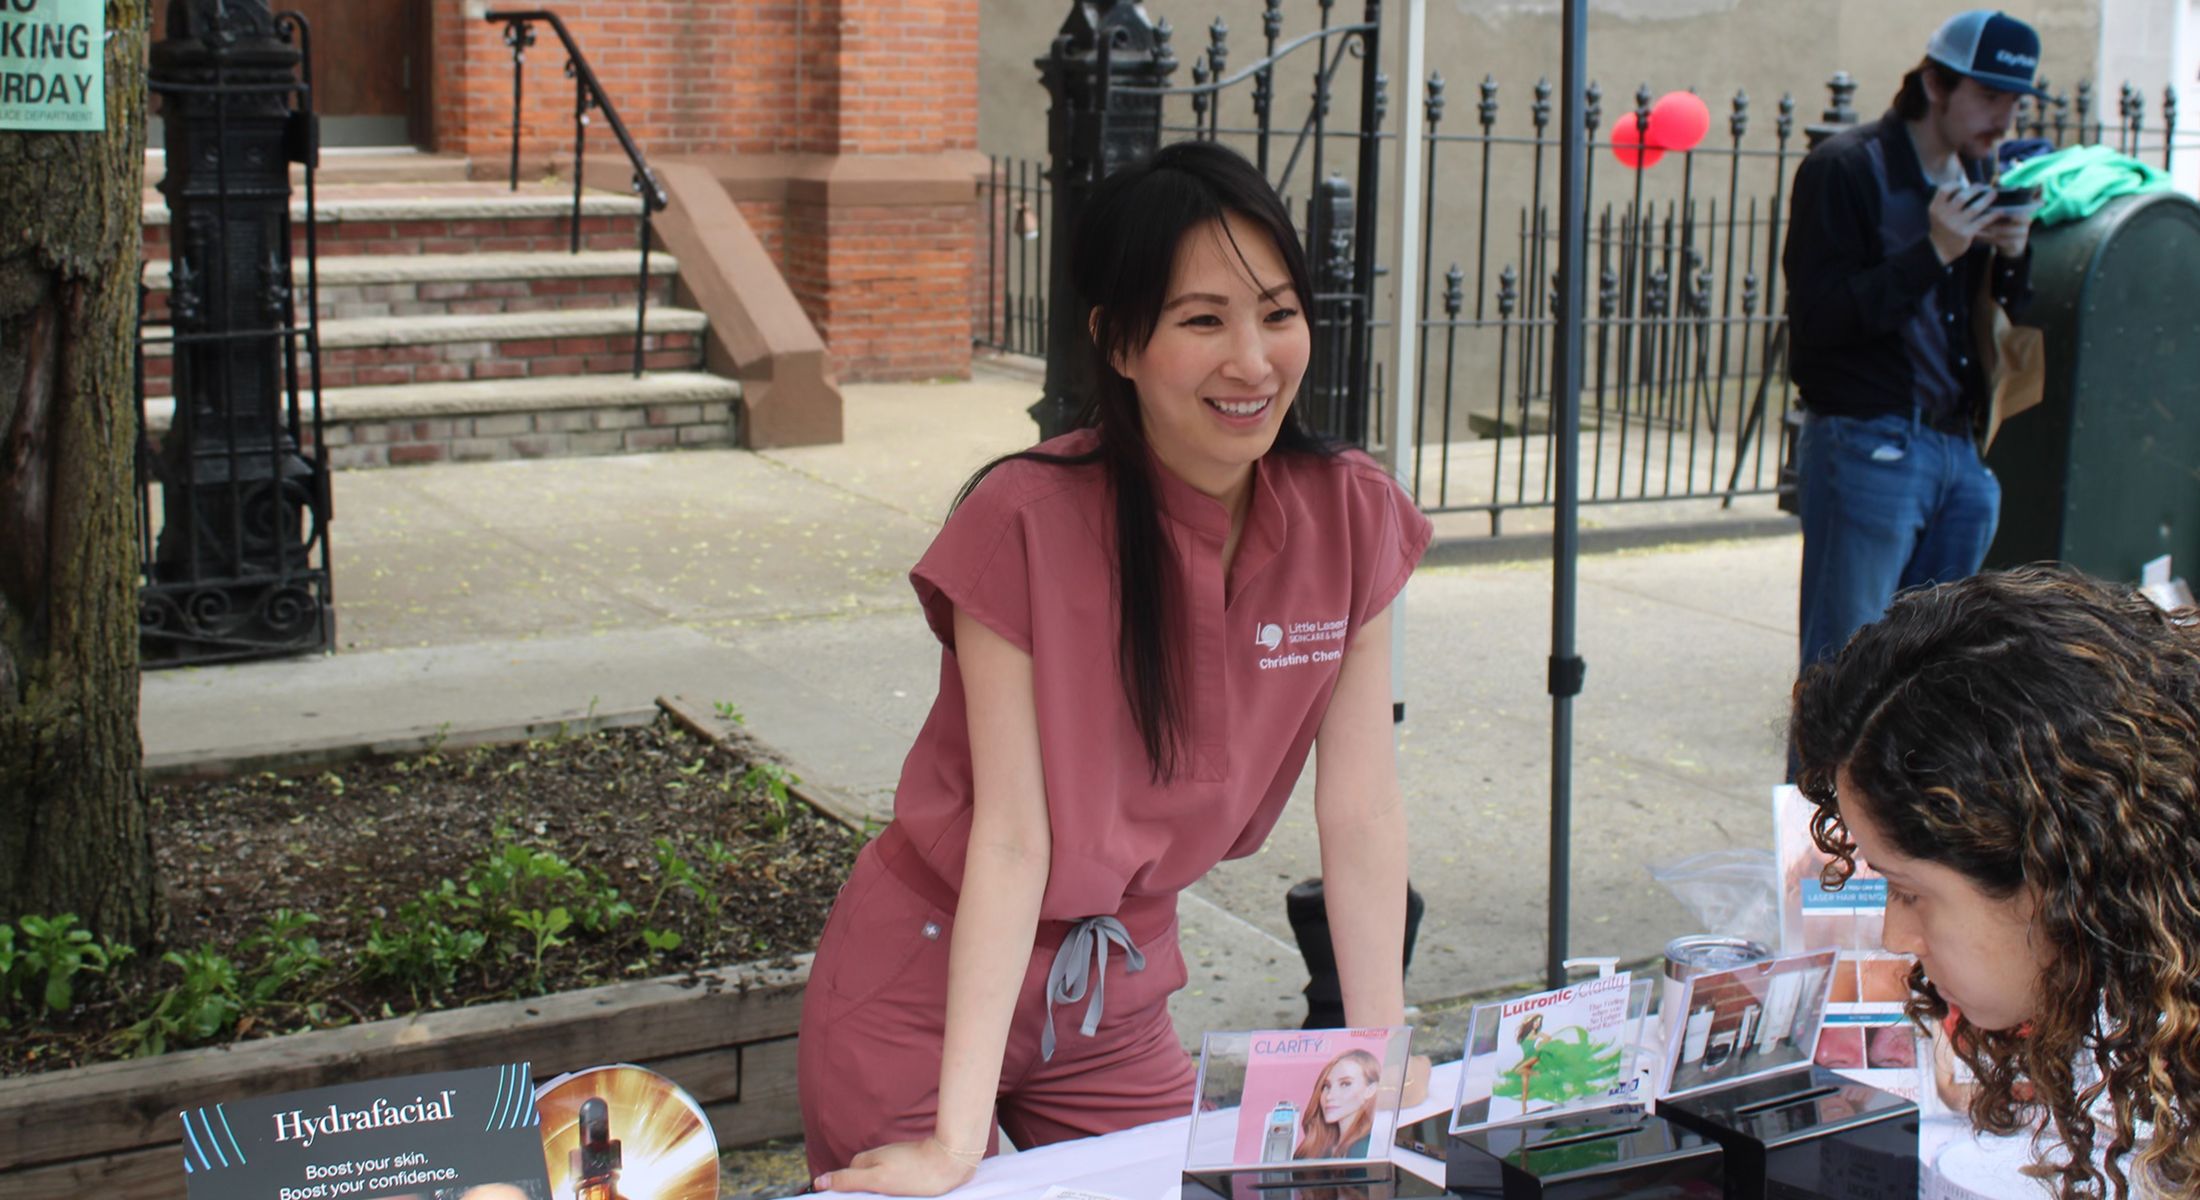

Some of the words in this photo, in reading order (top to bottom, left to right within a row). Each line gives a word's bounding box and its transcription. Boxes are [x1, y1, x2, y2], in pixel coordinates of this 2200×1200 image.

[1, 21, 90, 60] KING
[0, 71, 93, 105] RDAY
[24, 110, 94, 122] DEPARTMENT
[1288, 620, 1316, 634] Little
[1259, 652, 1310, 670] Christine
[1808, 893, 1835, 902] LASER
[1836, 893, 1857, 902] HAIR
[1503, 989, 1573, 1019] Lutronic
[1254, 1038, 1324, 1055] CLARITY
[305, 1160, 354, 1180] Boost
[355, 1156, 391, 1176] your
[279, 1183, 328, 1200] Boost
[330, 1178, 366, 1198] your
